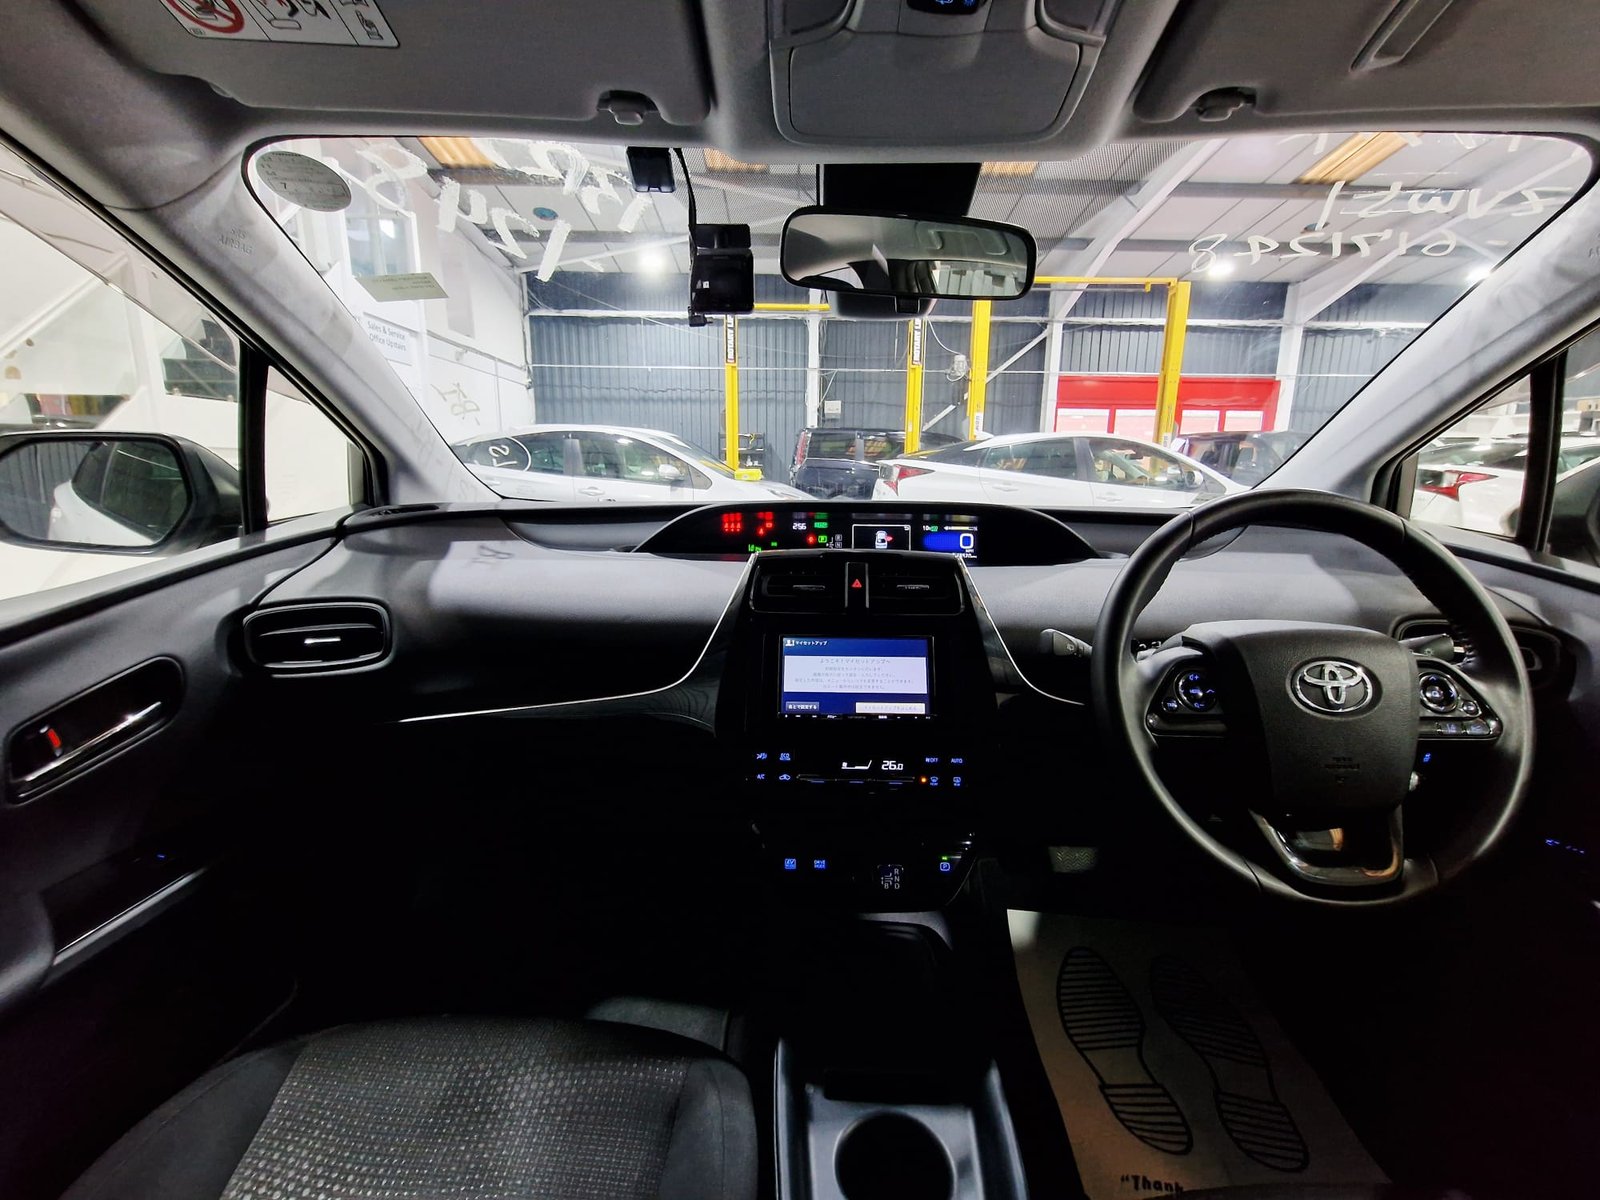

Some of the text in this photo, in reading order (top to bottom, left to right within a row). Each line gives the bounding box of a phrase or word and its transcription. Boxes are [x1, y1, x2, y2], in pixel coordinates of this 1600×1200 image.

[218, 234, 253, 255] AIRBAG
[367, 321, 381, 333] Sales
[388, 328, 405, 340] Service
[369, 333, 407, 352] Office Upstairs
